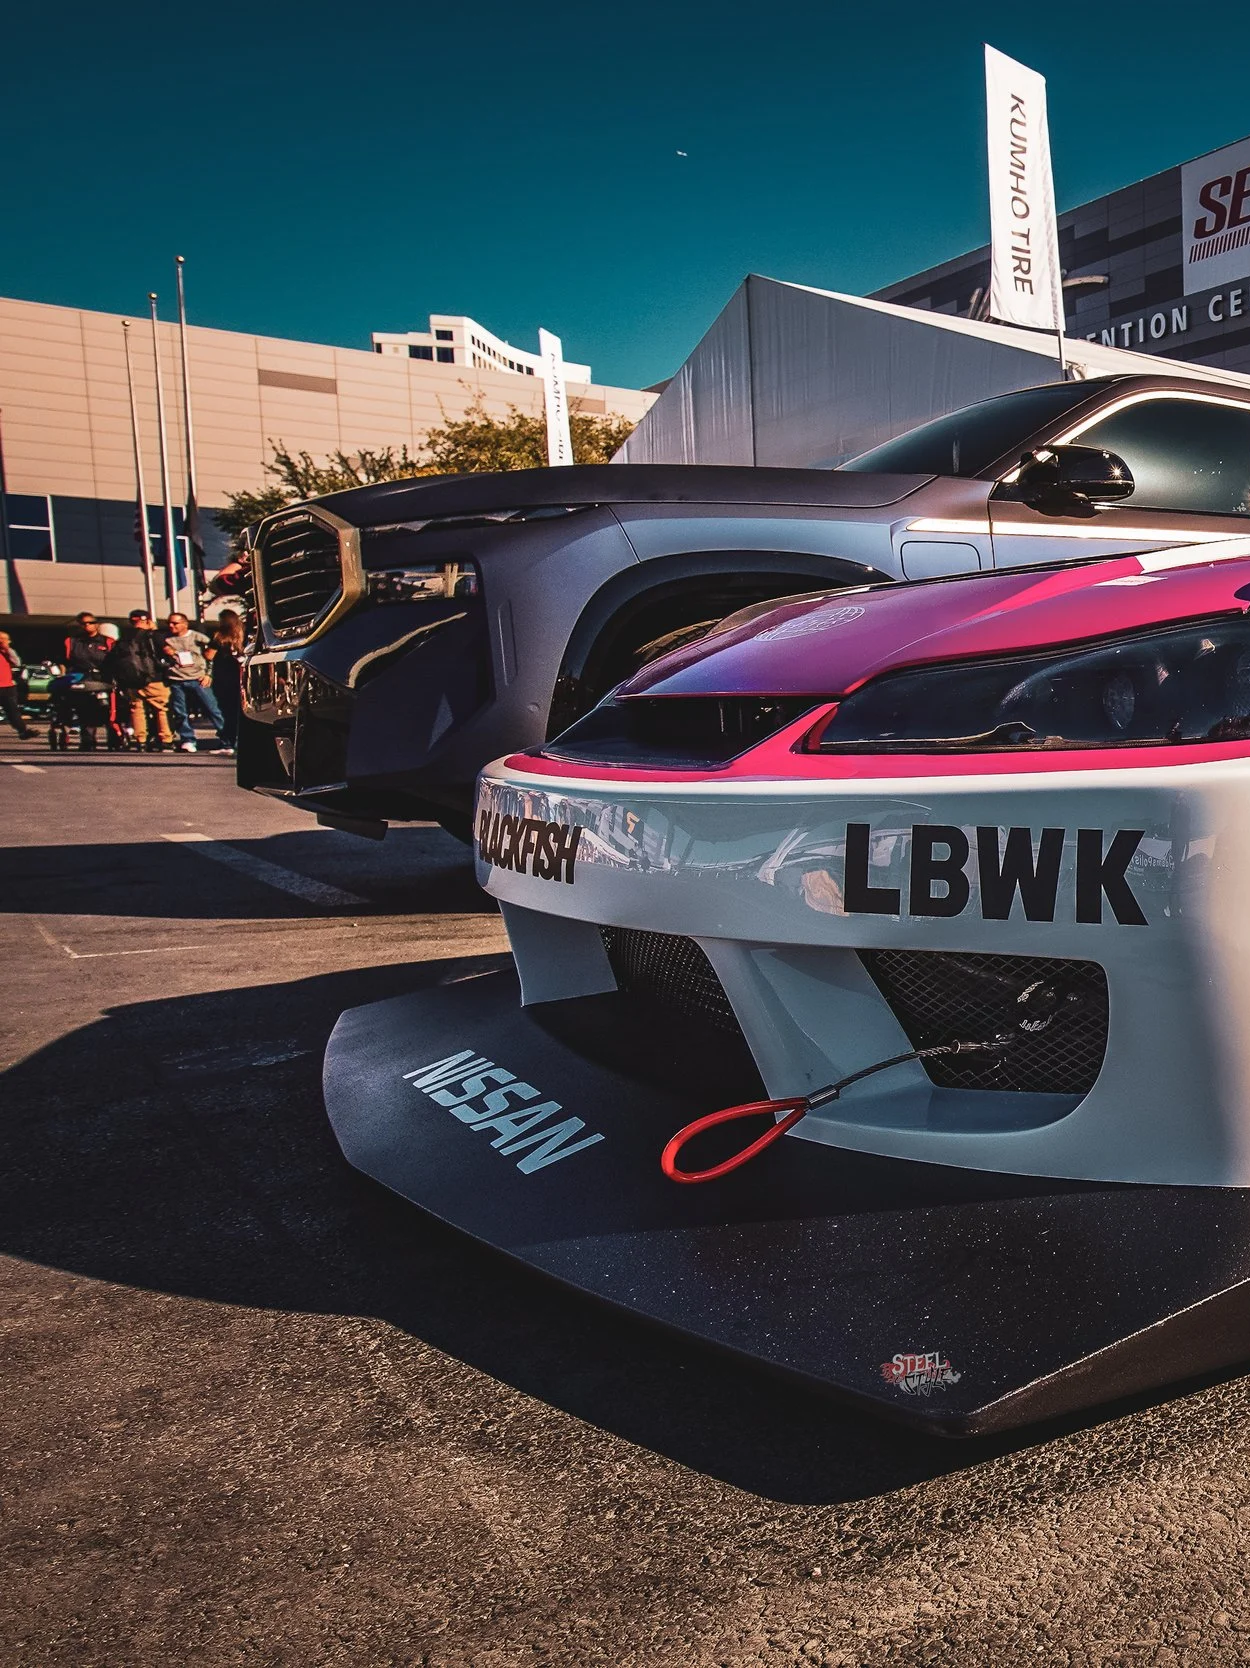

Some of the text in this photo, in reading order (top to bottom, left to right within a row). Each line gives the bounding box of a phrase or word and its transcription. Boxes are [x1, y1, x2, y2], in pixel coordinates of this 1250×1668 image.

[1009, 93, 1034, 295] KUMHO TIRE
[480, 809, 583, 885] BLACKFISH
[843, 822, 1150, 927] LBWK
[402, 1049, 606, 1175] NISSAN
[891, 1351, 948, 1376] STEEL
